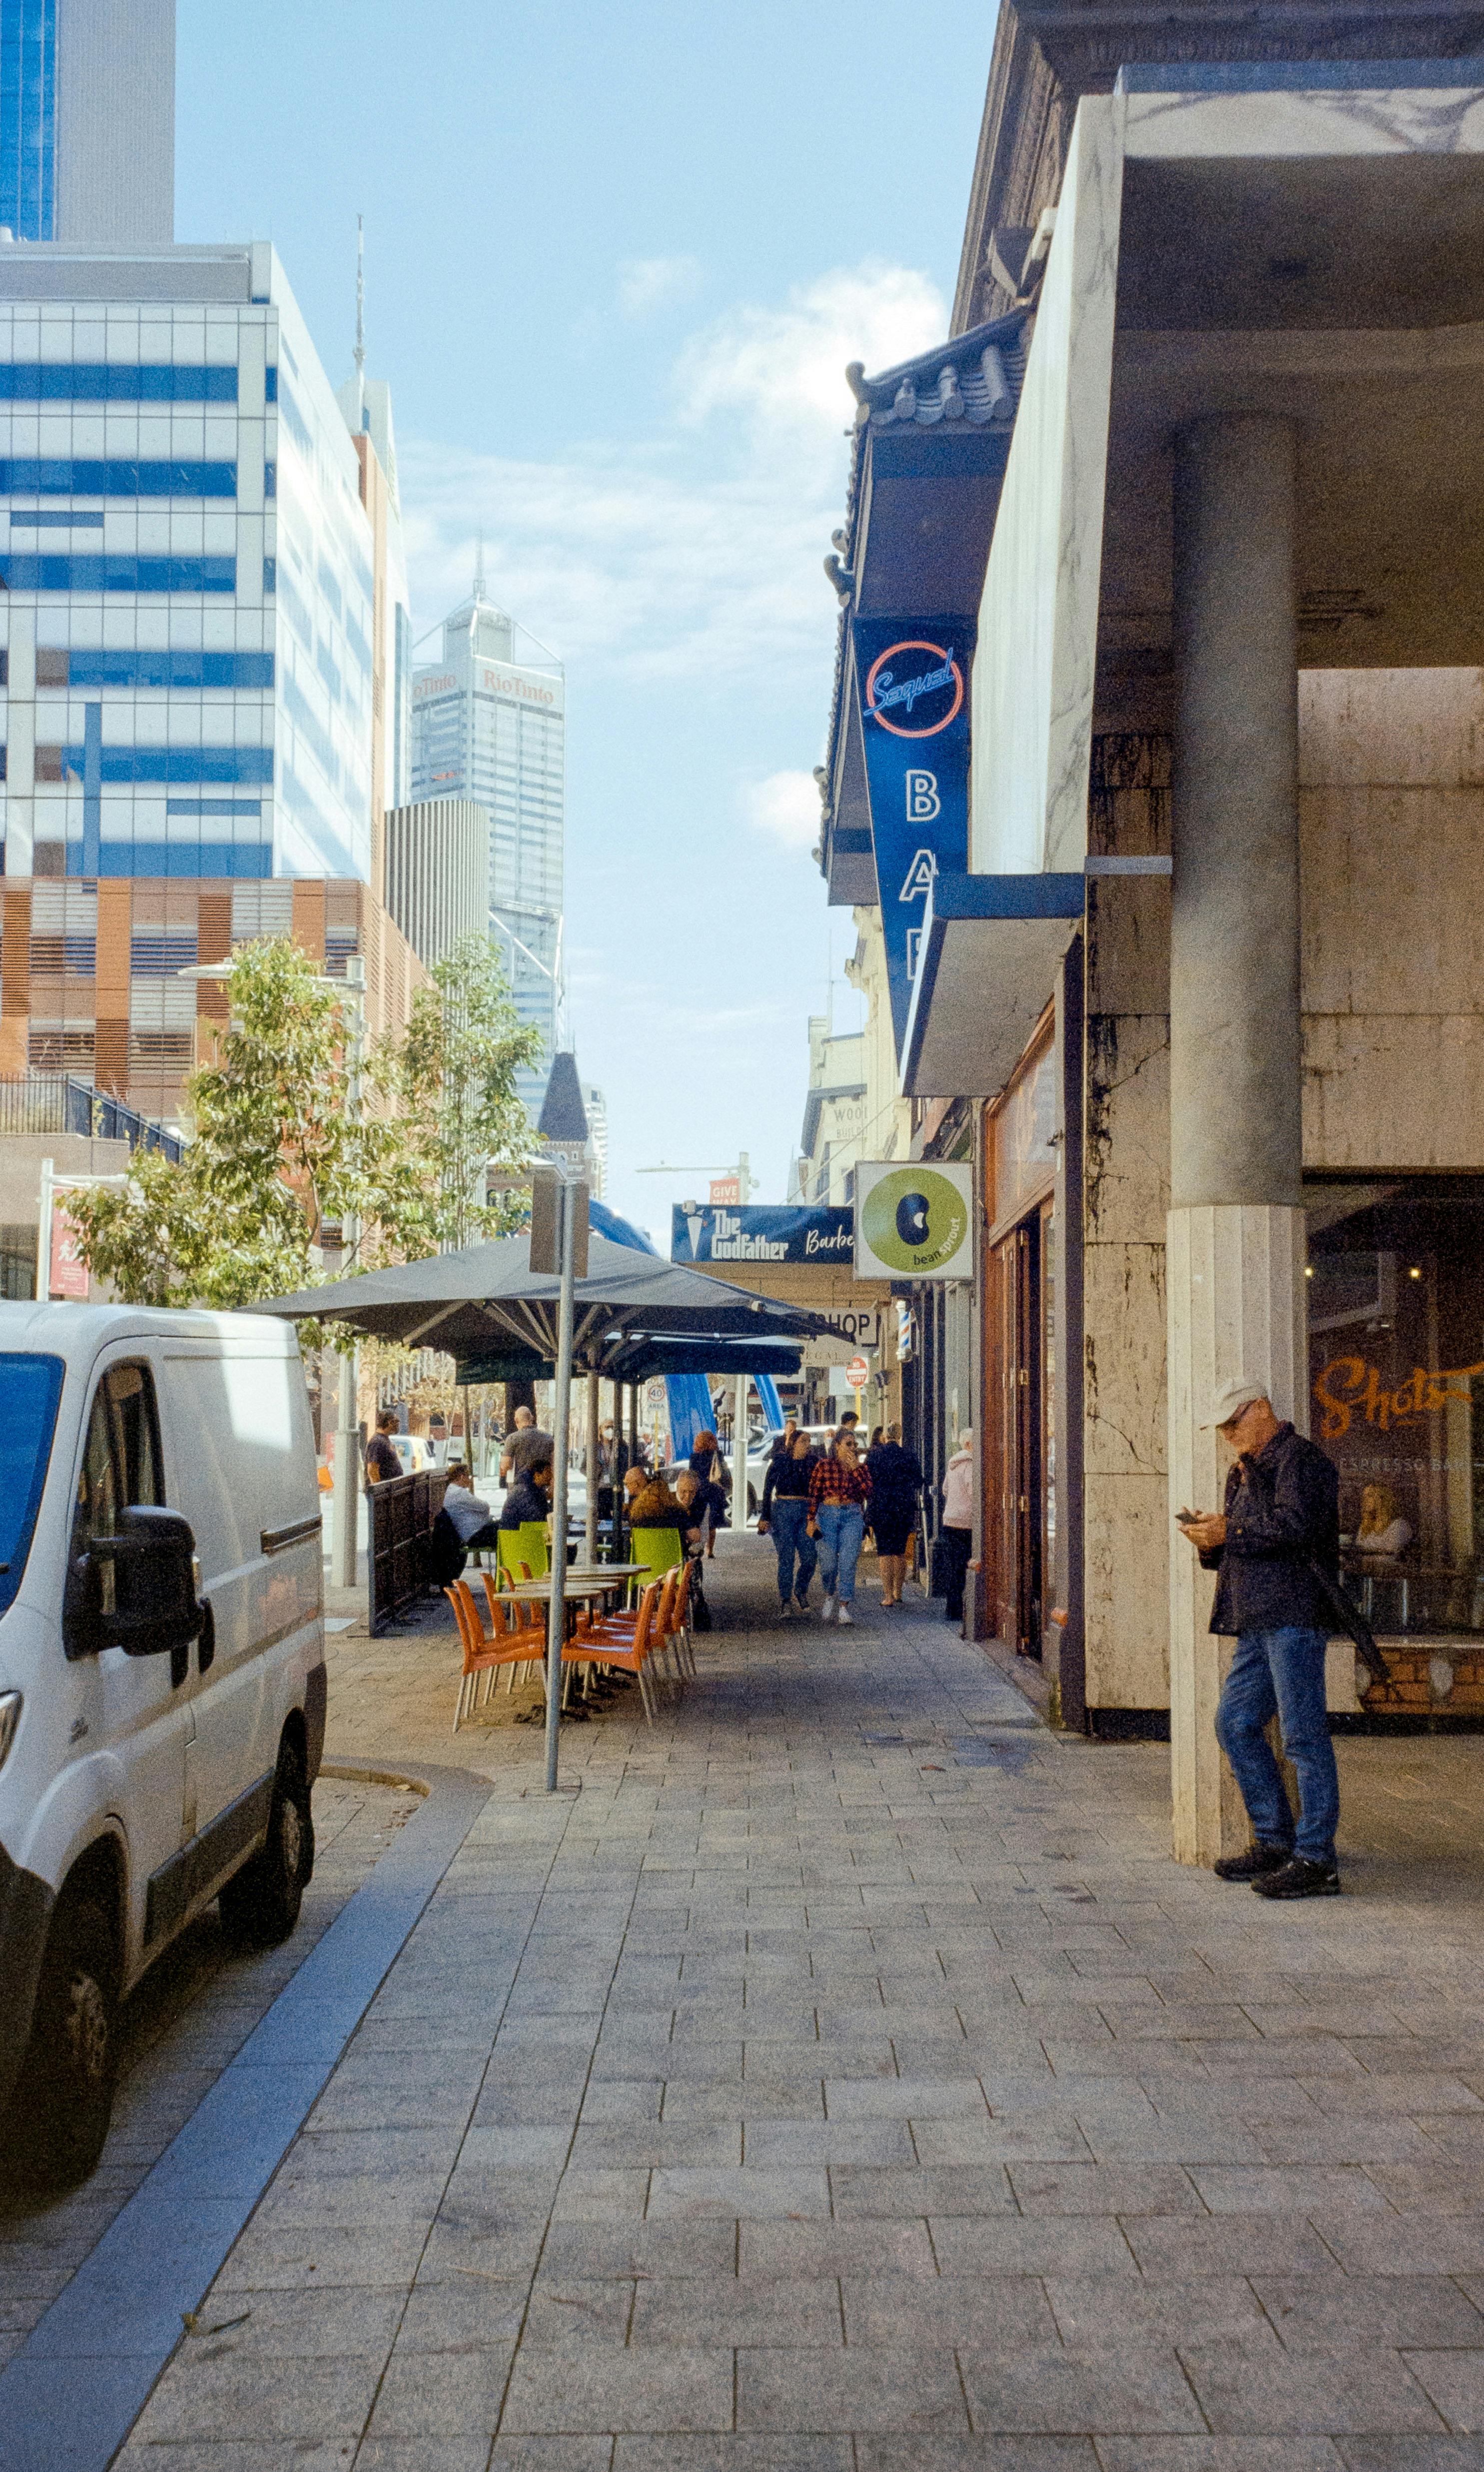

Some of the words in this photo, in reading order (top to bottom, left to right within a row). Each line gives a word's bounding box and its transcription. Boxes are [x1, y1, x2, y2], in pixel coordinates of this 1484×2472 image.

[864, 647, 954, 717] Sequel
[713, 1185, 738, 1197] GIVE
[712, 1209, 741, 1235] The
[711, 1233, 789, 1260] Godfather
[1315, 1356, 1484, 1440] Shots
[1339, 1458, 1425, 1472] ESPRESSO
